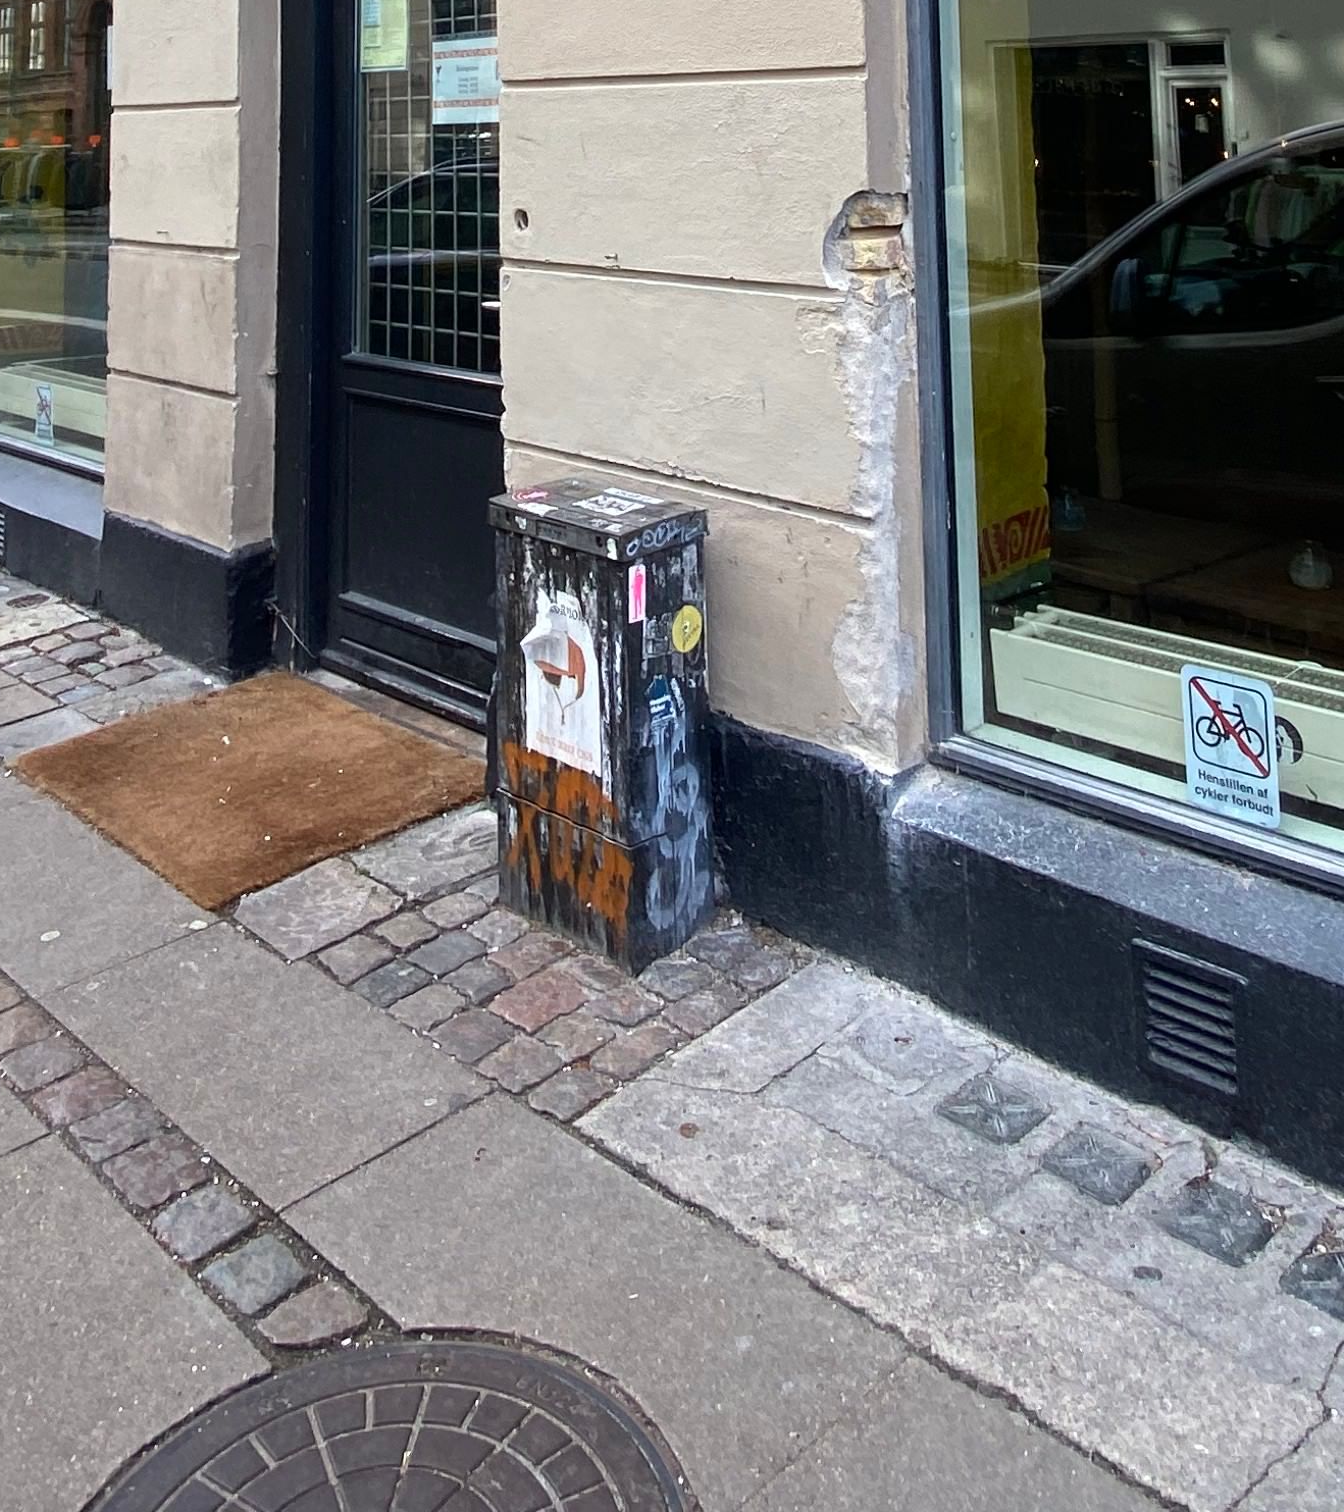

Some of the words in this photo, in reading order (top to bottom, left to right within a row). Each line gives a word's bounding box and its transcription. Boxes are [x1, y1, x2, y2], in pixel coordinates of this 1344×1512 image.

[1197, 768, 1254, 795] Henstillen
[1257, 788, 1269, 799] af
[1194, 785, 1229, 802] cykler
[1232, 794, 1274, 817] forbudt
